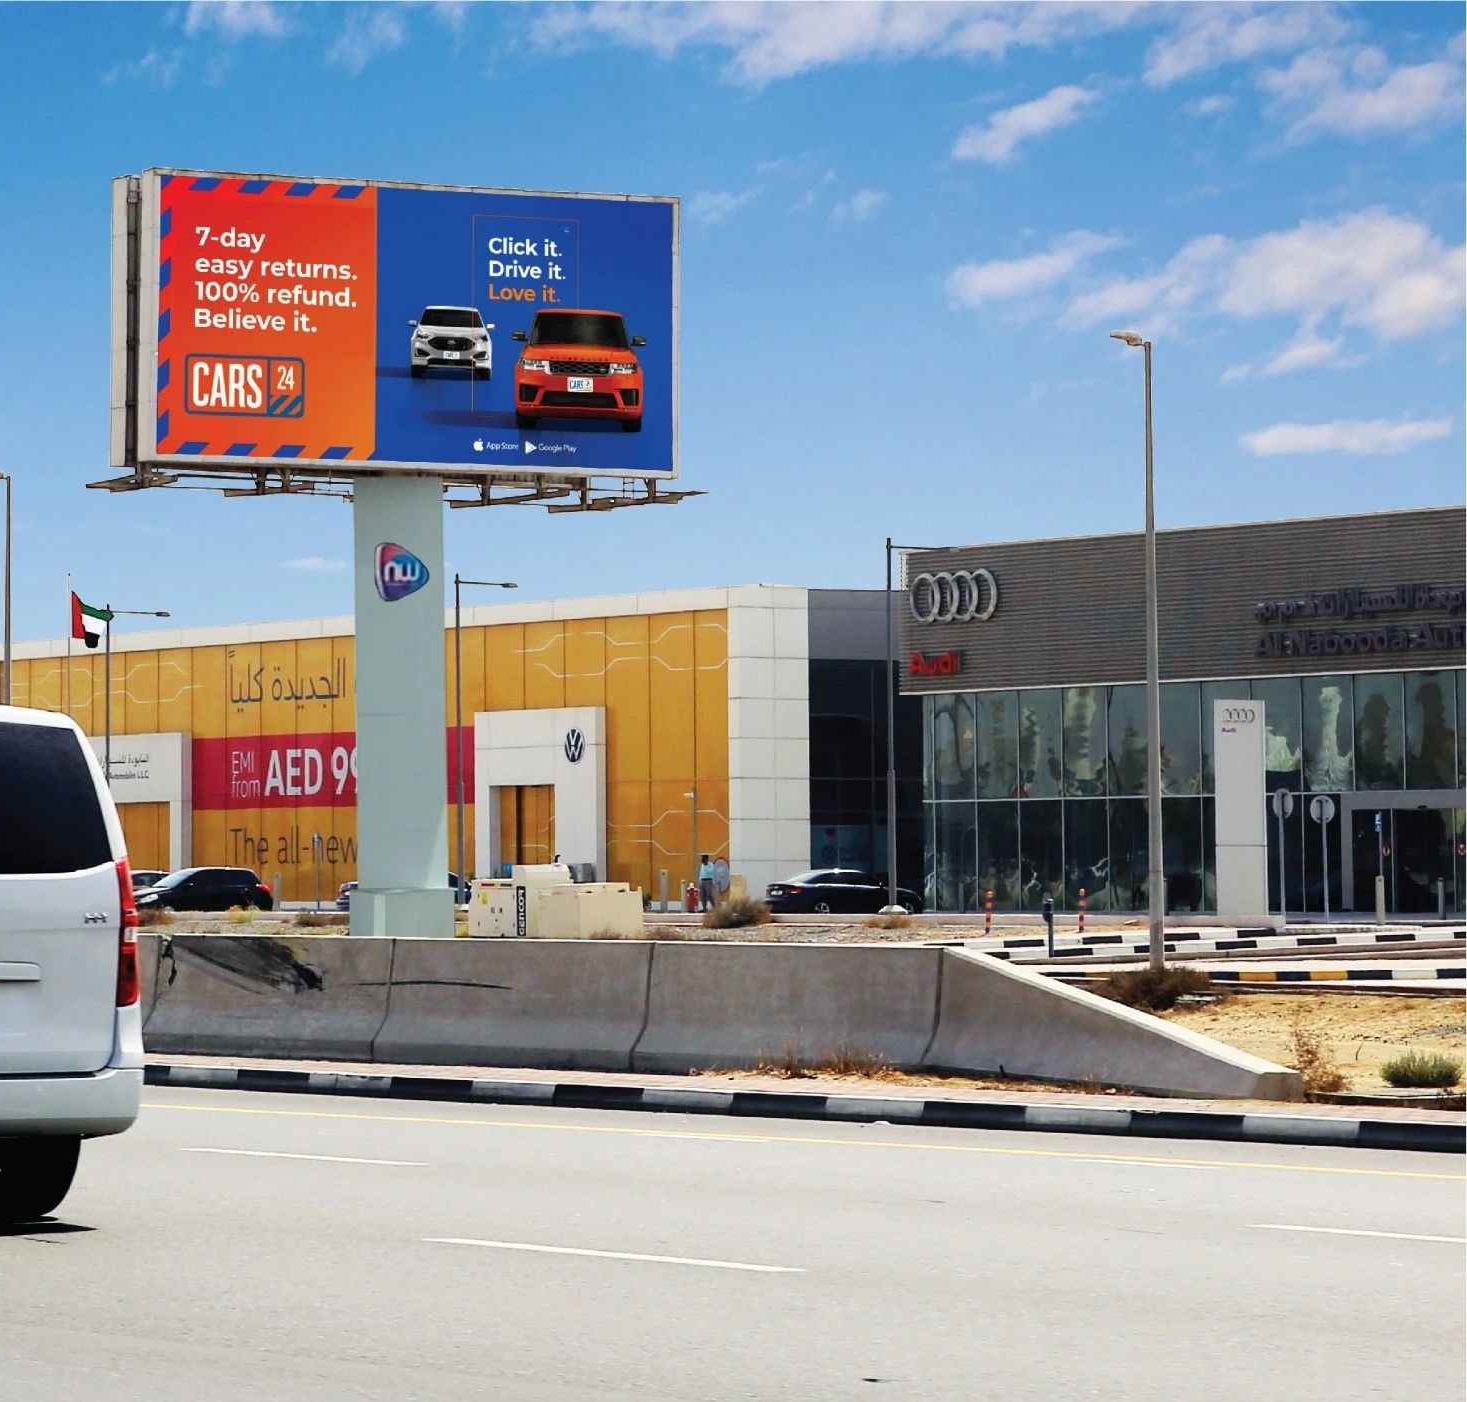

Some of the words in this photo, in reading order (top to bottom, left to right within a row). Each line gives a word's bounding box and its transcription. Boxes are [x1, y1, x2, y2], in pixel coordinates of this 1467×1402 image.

[195, 226, 266, 254] 7-day
[488, 236, 538, 256] Click
[544, 238, 563, 257] it.
[195, 257, 254, 280] easy
[261, 259, 358, 280] returns.
[488, 259, 542, 279] Drive
[548, 261, 566, 280] it.
[194, 280, 260, 303] 100%
[267, 284, 357, 308] refund.
[488, 283, 536, 302] Love
[542, 284, 561, 303] it.
[194, 307, 285, 331] Believe
[293, 310, 318, 333] it.
[193, 361, 262, 409] CARS
[277, 365, 295, 390] 24
[570, 380, 584, 389] CARS
[486, 441, 500, 451] App
[501, 441, 519, 451] Store
[538, 443, 562, 453] Google
[563, 444, 577, 453] Play
[1289, 625, 1409, 656] Nabooda
[908, 649, 961, 676] Audi
[271, 656, 346, 709] الجديدة
[232, 751, 254, 773] EMI
[264, 748, 324, 797] AED
[232, 774, 261, 798] from
[230, 828, 269, 865] The
